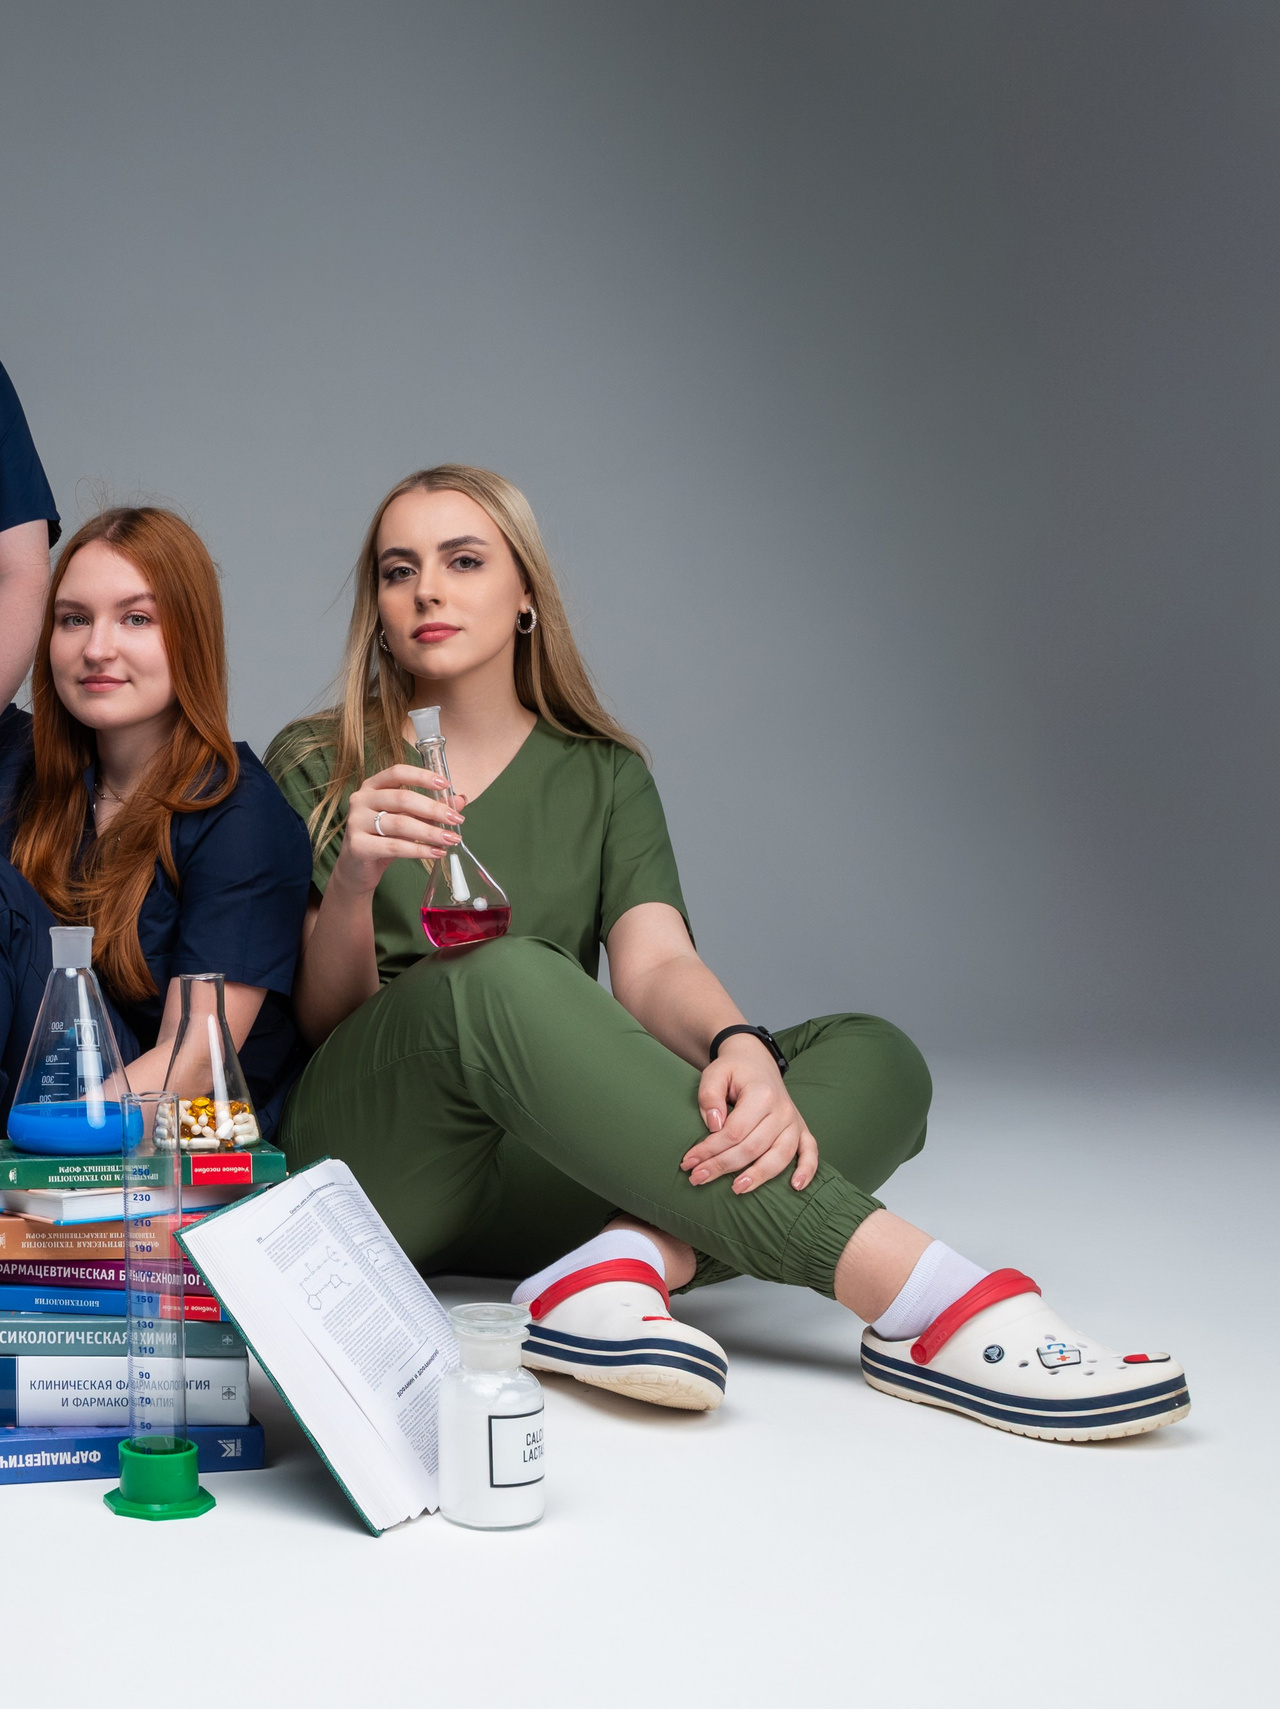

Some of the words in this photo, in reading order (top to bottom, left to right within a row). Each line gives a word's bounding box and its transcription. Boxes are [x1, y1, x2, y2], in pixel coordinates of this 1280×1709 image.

[134, 1244, 152, 1253] 190
[120, 1270, 206, 1286] БИОТЕХНОЛОГ
[34, 1298, 100, 1307] БИОТЕХНОЛОГИЯ
[140, 1332, 177, 1345] ХИМИЯ
[30, 1380, 112, 1390] КЛИНИЧЕСКАЯ
[62, 1398, 69, 1407] И
